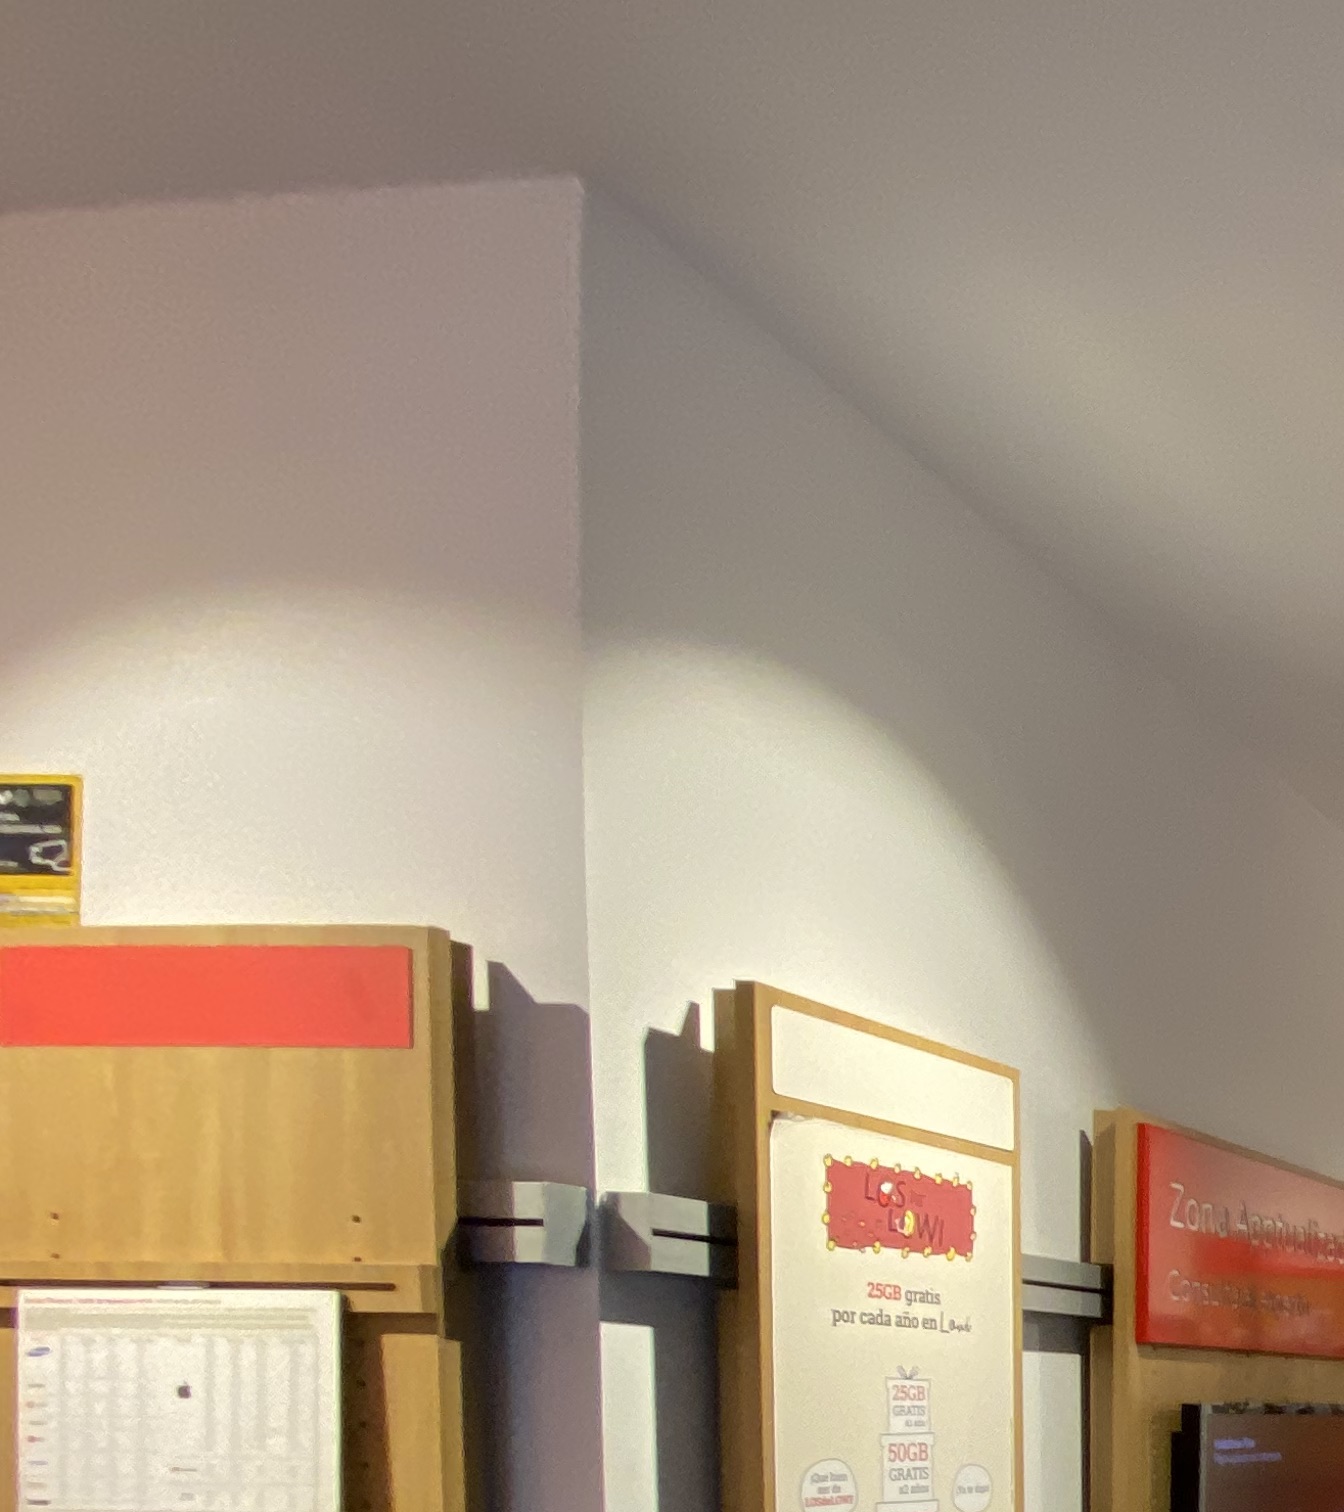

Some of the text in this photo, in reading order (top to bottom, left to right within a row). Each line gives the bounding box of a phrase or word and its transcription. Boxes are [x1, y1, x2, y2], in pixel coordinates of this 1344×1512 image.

[1169, 1181, 1230, 1238] Zona
[866, 1282, 941, 1306] 25GB gratis
[832, 1309, 856, 1327] por
[859, 1309, 892, 1327] cada
[895, 1312, 919, 1329] año
[922, 1317, 938, 1330] en
[892, 1384, 926, 1401] 25GB
[892, 1405, 926, 1418] GRATIS
[888, 1442, 929, 1462] 50GB
[889, 1467, 930, 1482] GRATIS
